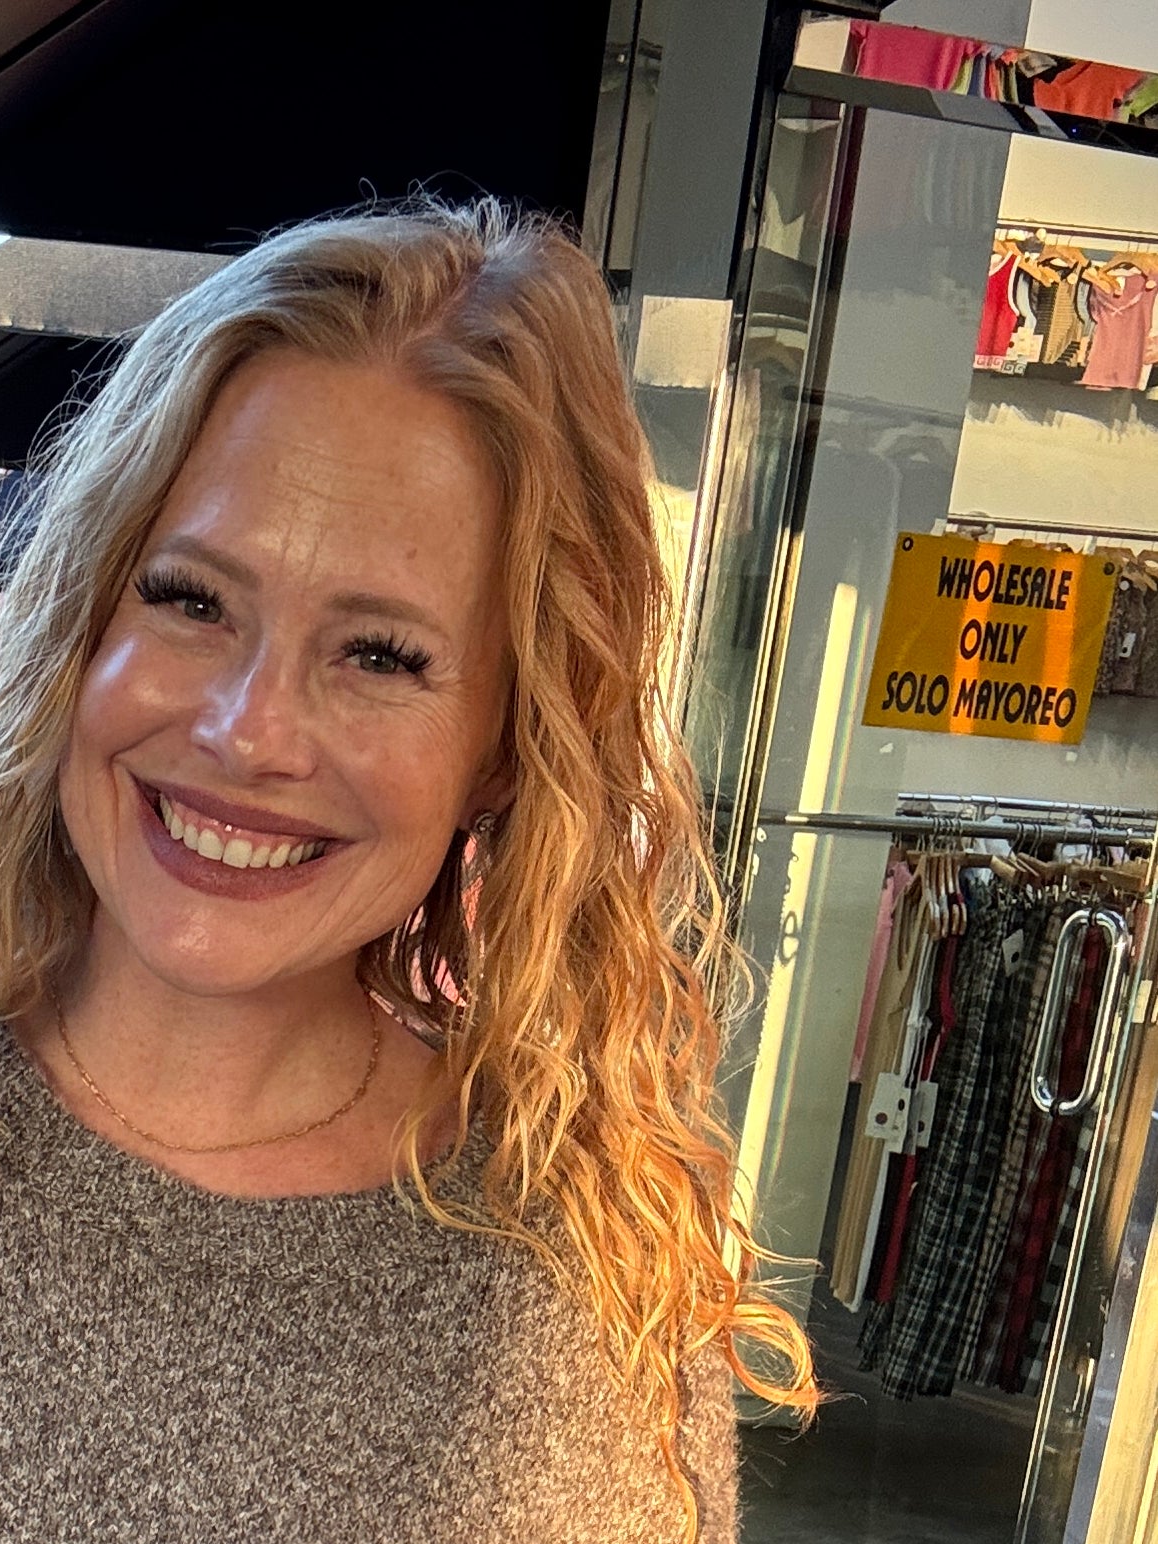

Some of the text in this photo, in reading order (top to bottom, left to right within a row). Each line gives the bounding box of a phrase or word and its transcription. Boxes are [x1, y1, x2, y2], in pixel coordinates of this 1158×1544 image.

[938, 556, 1073, 610] WHOLESALE
[959, 618, 1028, 665] ONLY
[882, 671, 1077, 728] SOLO MAYOREO
